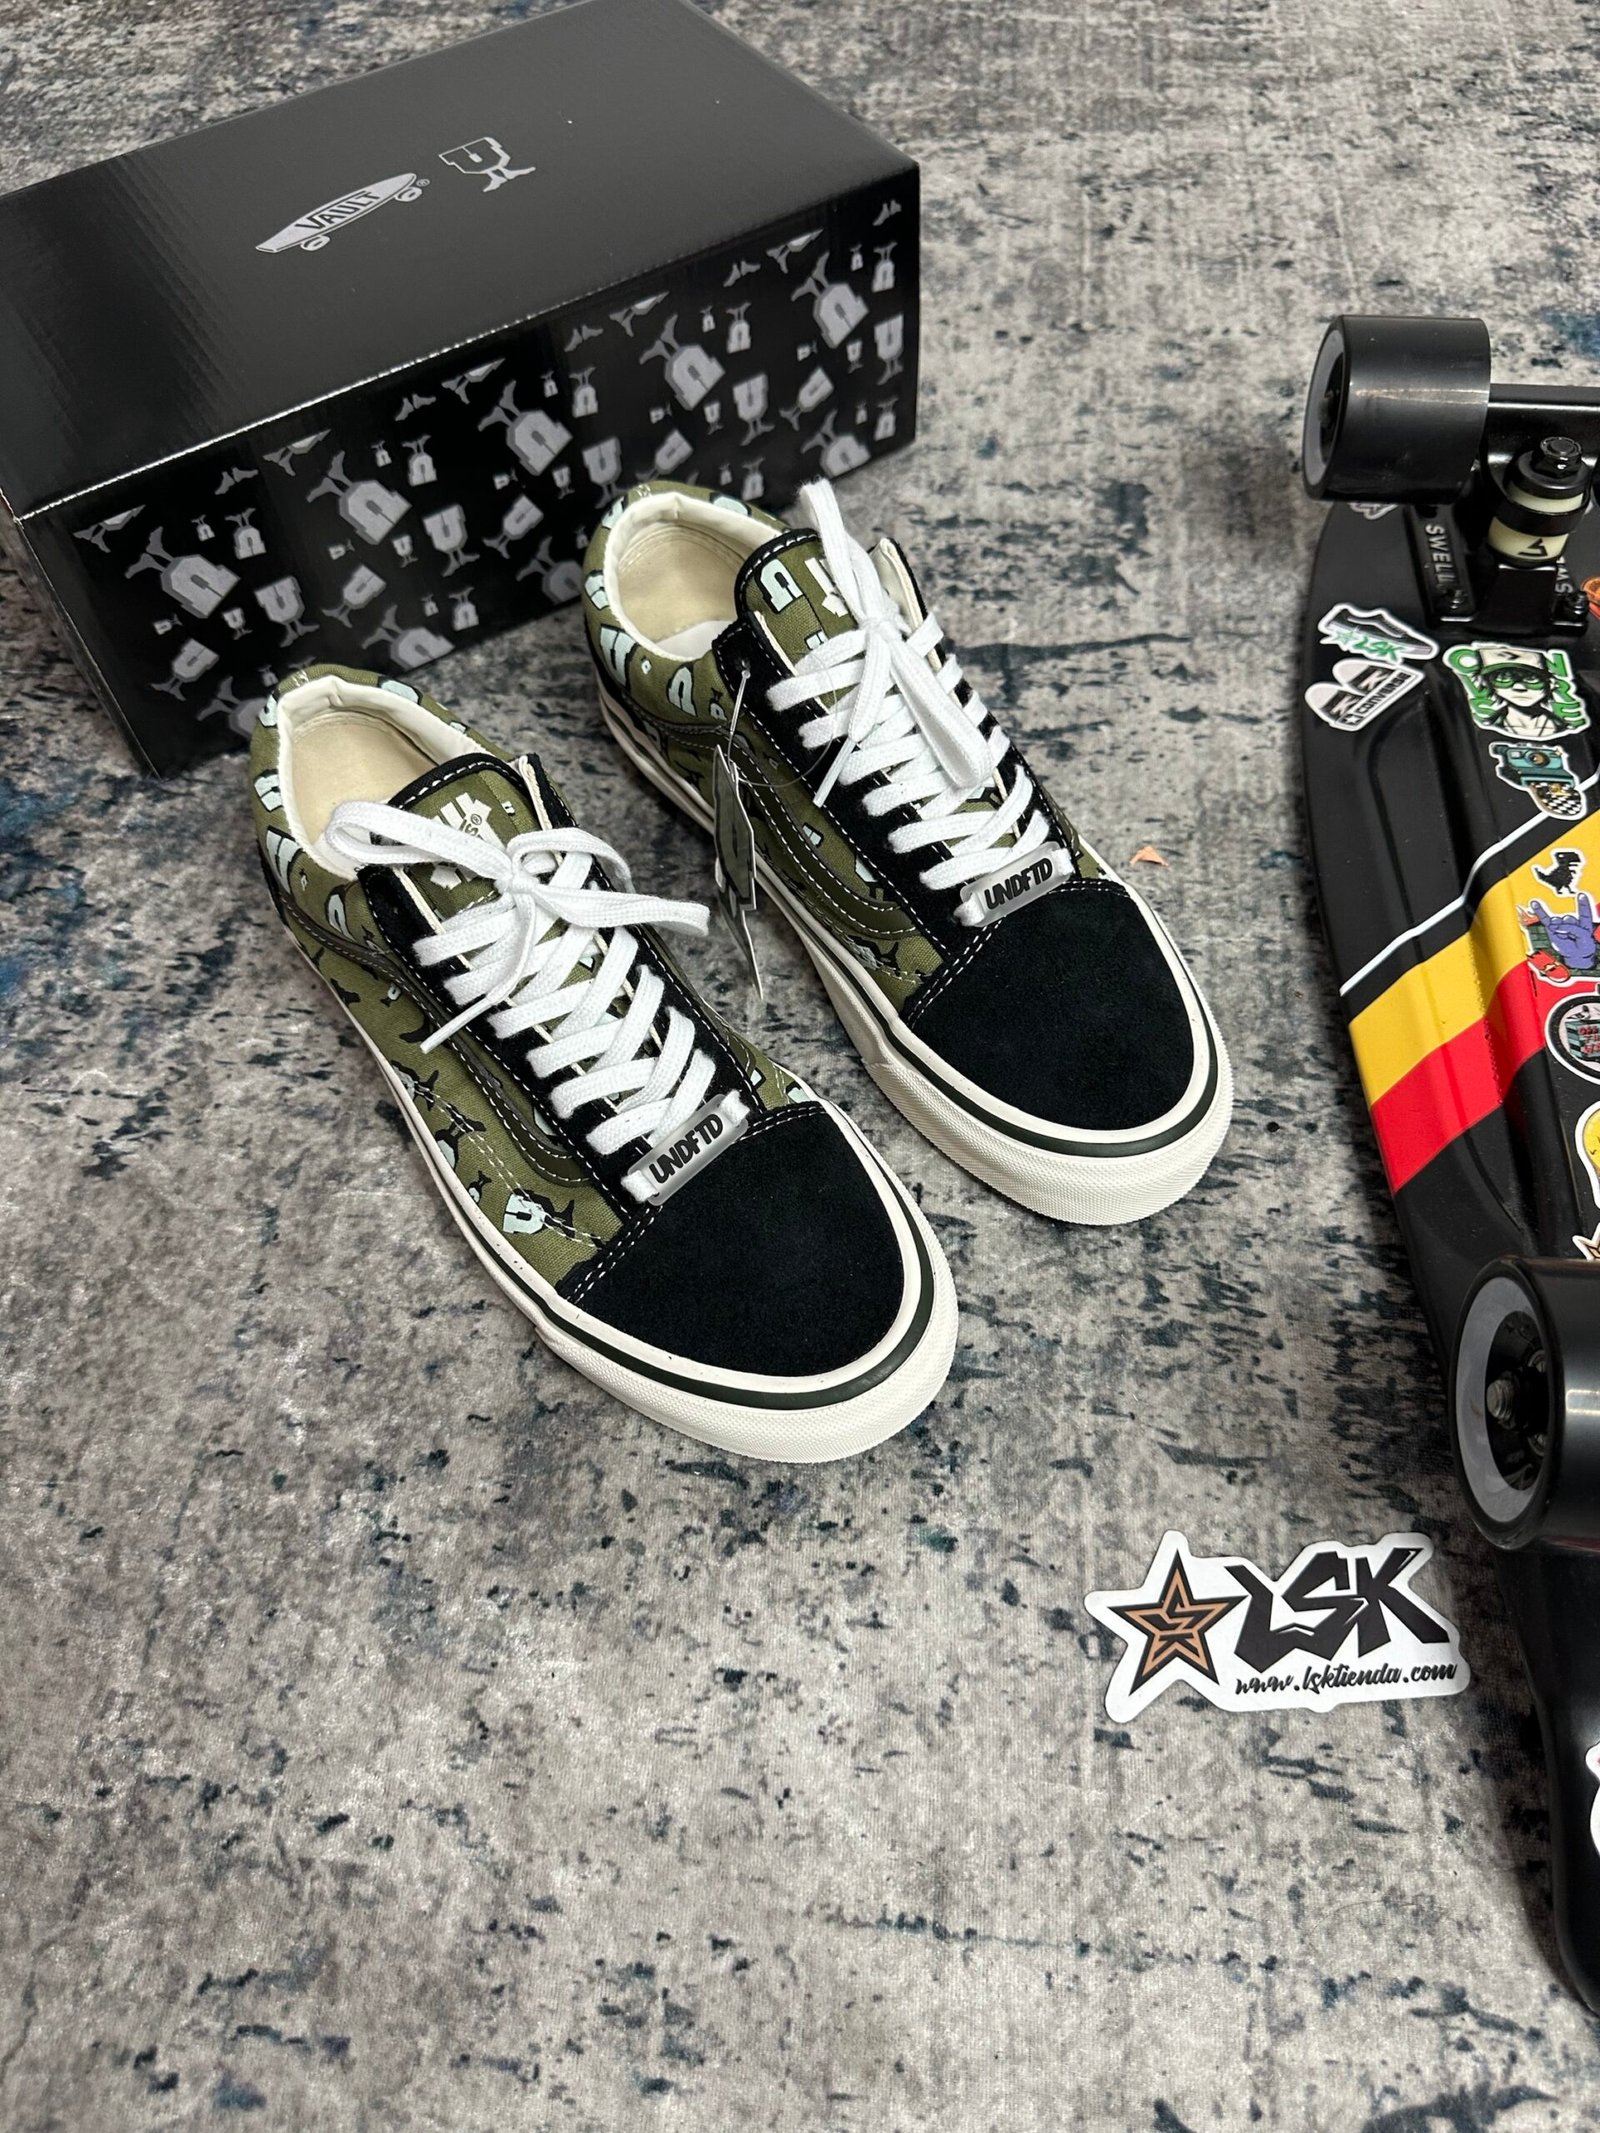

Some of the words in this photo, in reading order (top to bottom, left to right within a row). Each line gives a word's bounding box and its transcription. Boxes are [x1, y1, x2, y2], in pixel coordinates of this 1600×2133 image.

[294, 190, 381, 230] VAULT
[1425, 524, 1456, 586] SWELL
[984, 858, 1053, 910] UNDFTD
[649, 1113, 723, 1184] UNDFTD
[1224, 1547, 1451, 1674] LSK
[1235, 1663, 1458, 1695] www.lsktienda.com
